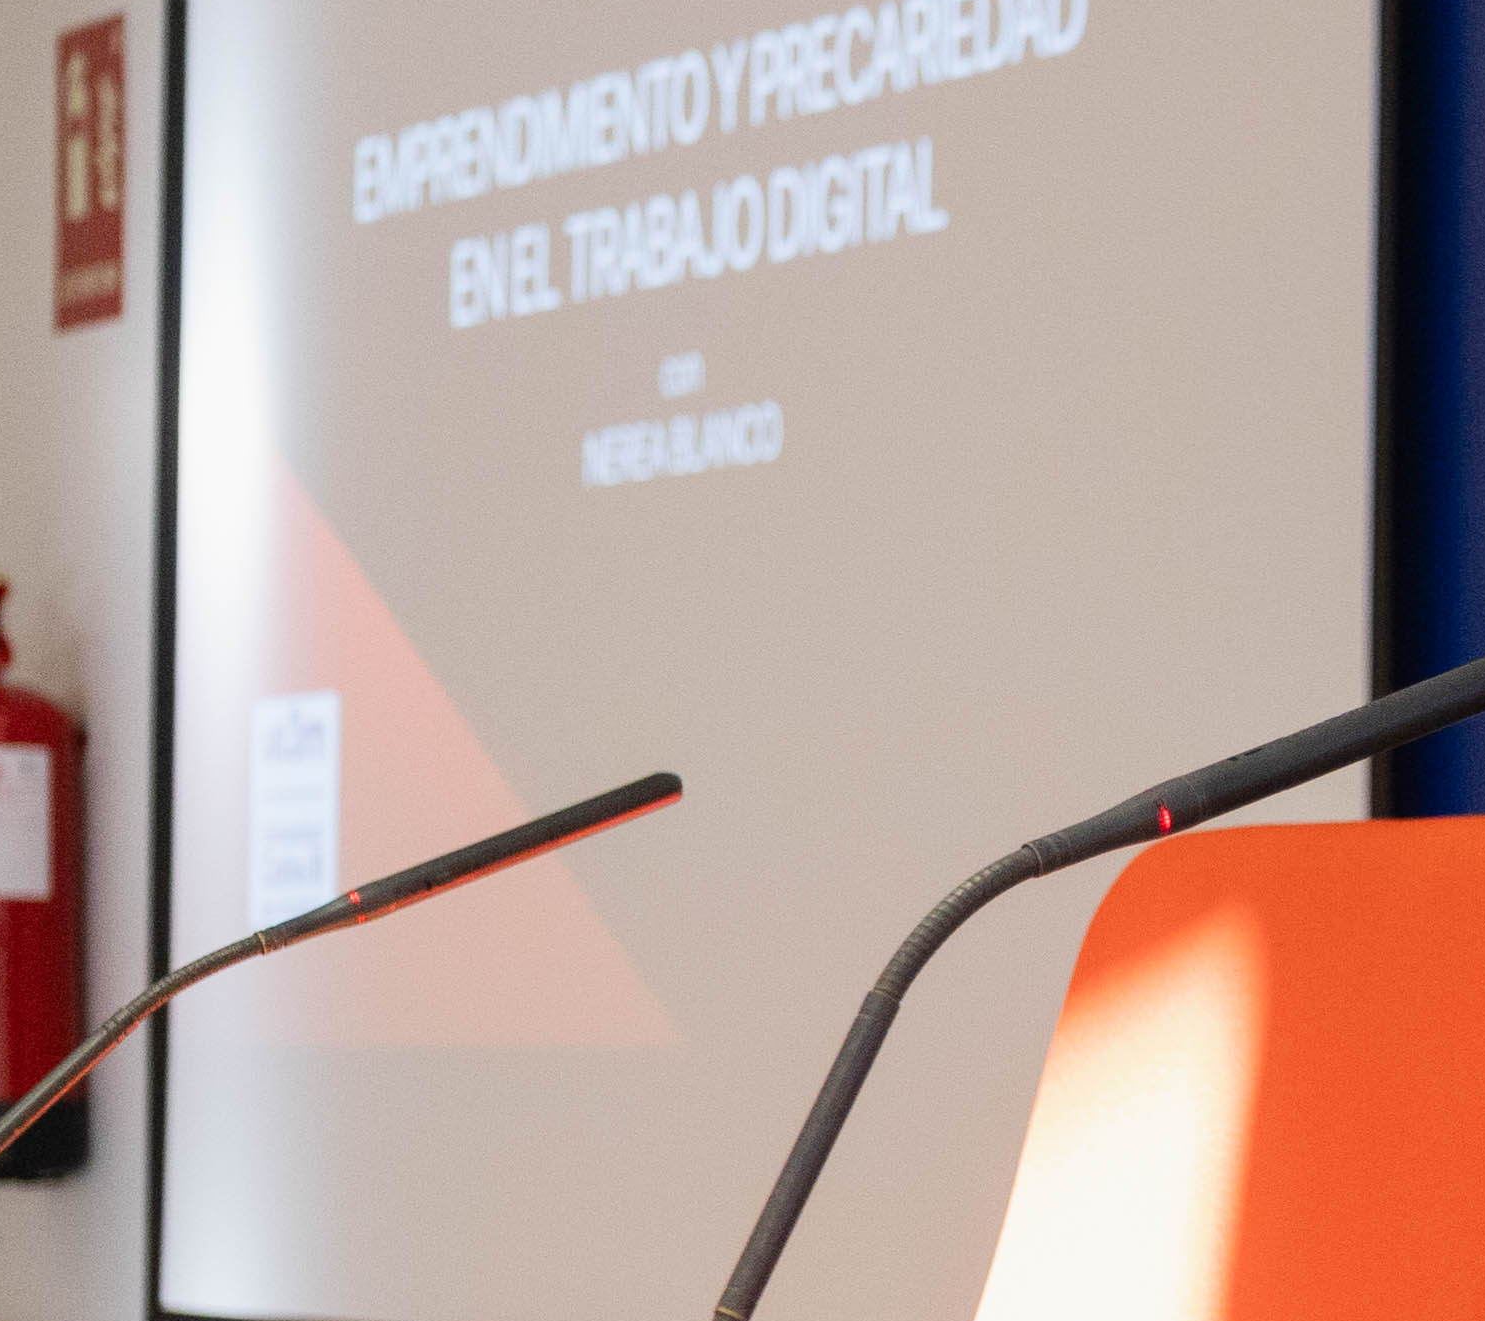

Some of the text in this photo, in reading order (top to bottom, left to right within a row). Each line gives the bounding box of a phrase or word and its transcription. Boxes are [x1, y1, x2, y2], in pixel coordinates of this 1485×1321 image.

[711, 37, 748, 134] Y
[449, 136, 951, 328] EN EL TRABAJO DIGITAL
